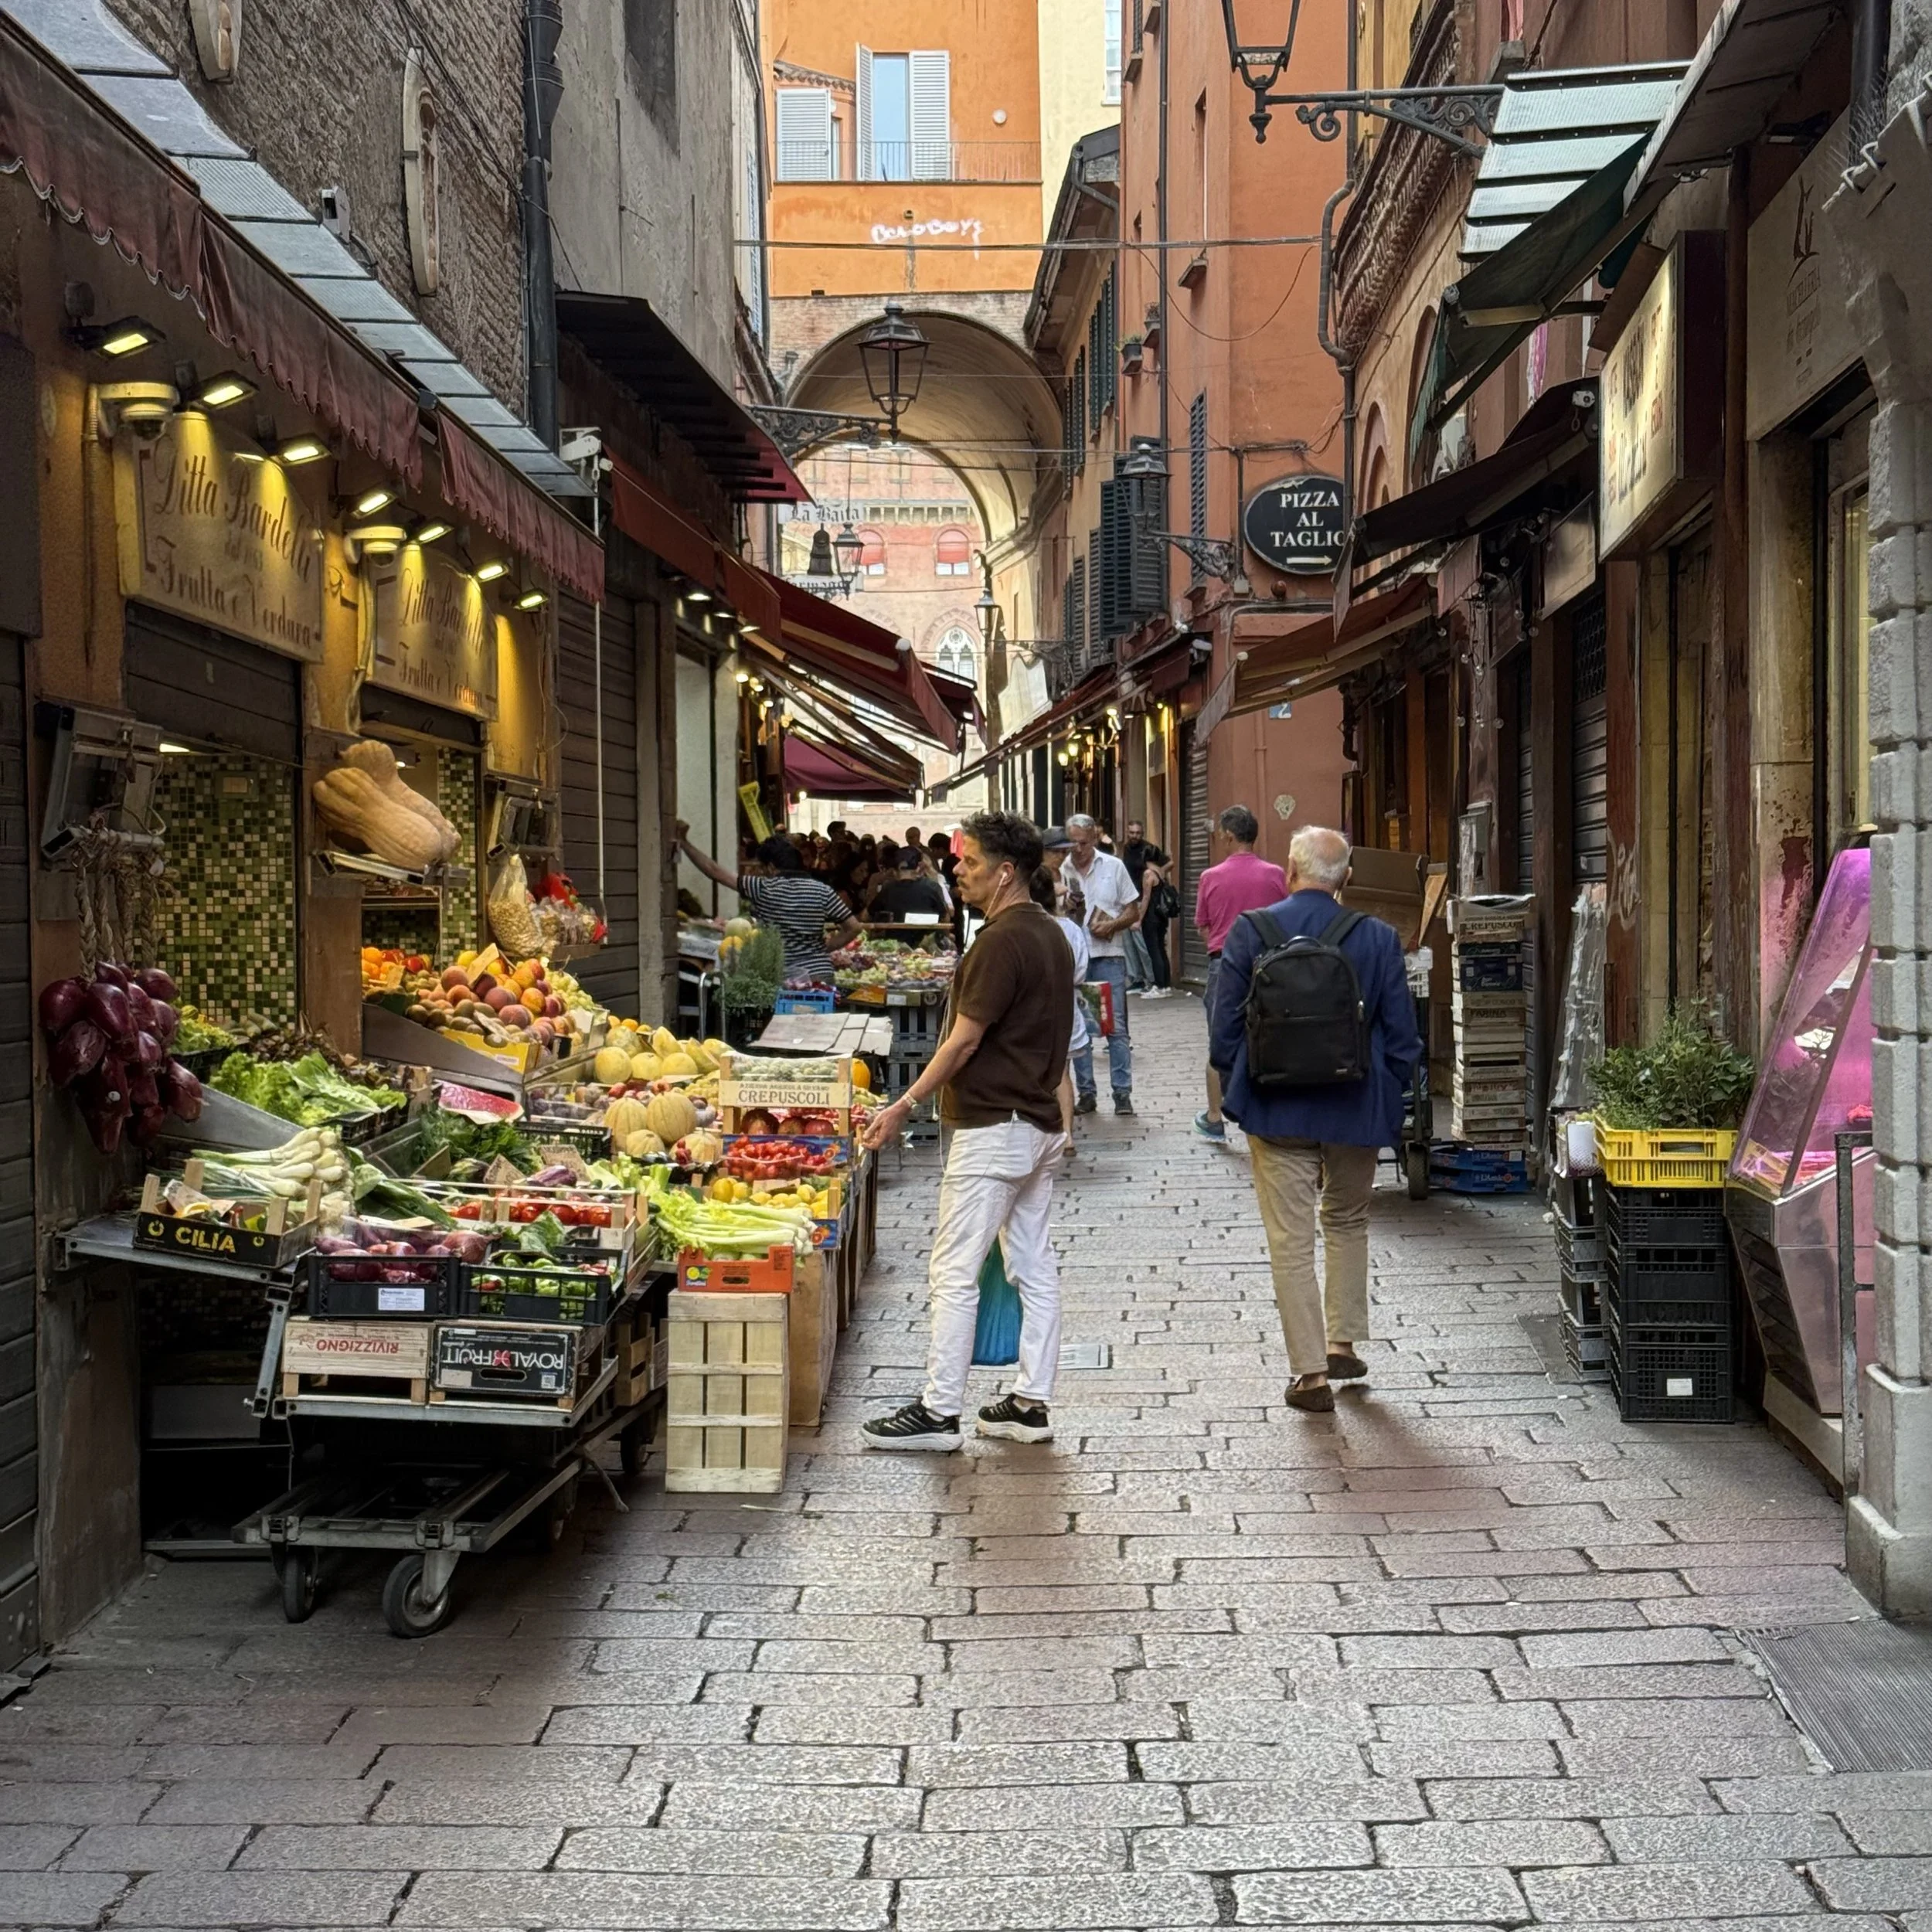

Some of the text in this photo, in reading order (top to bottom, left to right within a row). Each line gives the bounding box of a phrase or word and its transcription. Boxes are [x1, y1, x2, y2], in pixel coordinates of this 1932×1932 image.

[155, 434, 218, 516] Ditta
[1280, 491, 1339, 508] PIZZA
[1296, 512, 1324, 527] AL
[156, 535, 226, 616] Frutta
[241, 573, 311, 649] Verdura
[400, 568, 434, 627] Ditta
[399, 641, 434, 692] Frutta
[738, 1090, 830, 1105] CREPUSCOLI
[175, 1226, 236, 1253] CILIA
[317, 1339, 399, 1354] RIVIZZIGNO
[442, 1347, 563, 1369] ROYAL FRUIT
